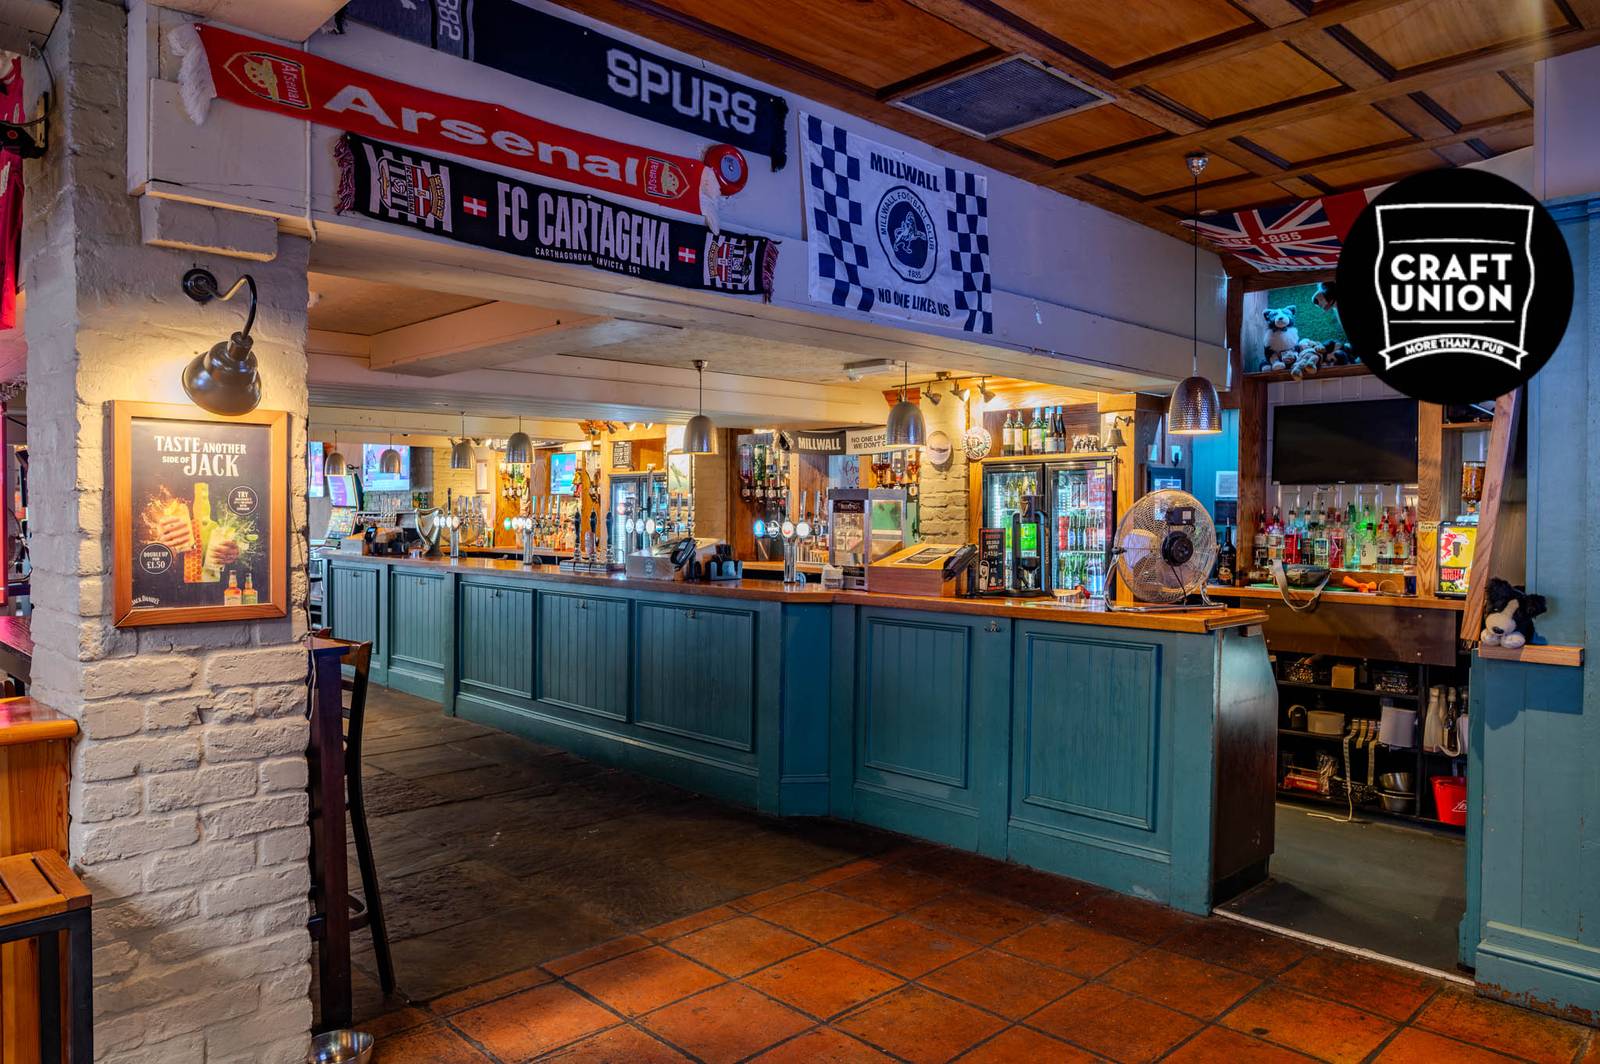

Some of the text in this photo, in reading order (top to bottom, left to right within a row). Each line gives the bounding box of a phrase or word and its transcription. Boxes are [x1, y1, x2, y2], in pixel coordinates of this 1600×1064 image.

[281, 62, 304, 105] Arsenal
[606, 47, 758, 136] SPURS
[323, 84, 640, 196] Arsenal
[647, 160, 659, 193] Arsenal
[870, 152, 940, 193] MILLWALL
[496, 180, 529, 242] FC
[537, 191, 671, 272] CARTAGENA
[880, 191, 935, 251] MILLWALL FOOTBALL CLUB
[1222, 231, 1302, 245] EST 1885
[596, 256, 624, 271] INVICTA
[877, 287, 951, 317] NO ONE LIKES US
[154, 435, 247, 455] TASTE ANOTHER
[797, 436, 841, 451] MILLWALL
[863, 441, 881, 449] DON'T
[162, 453, 240, 477] SIDE OF JACK
[147, 560, 166, 569] £1.50
